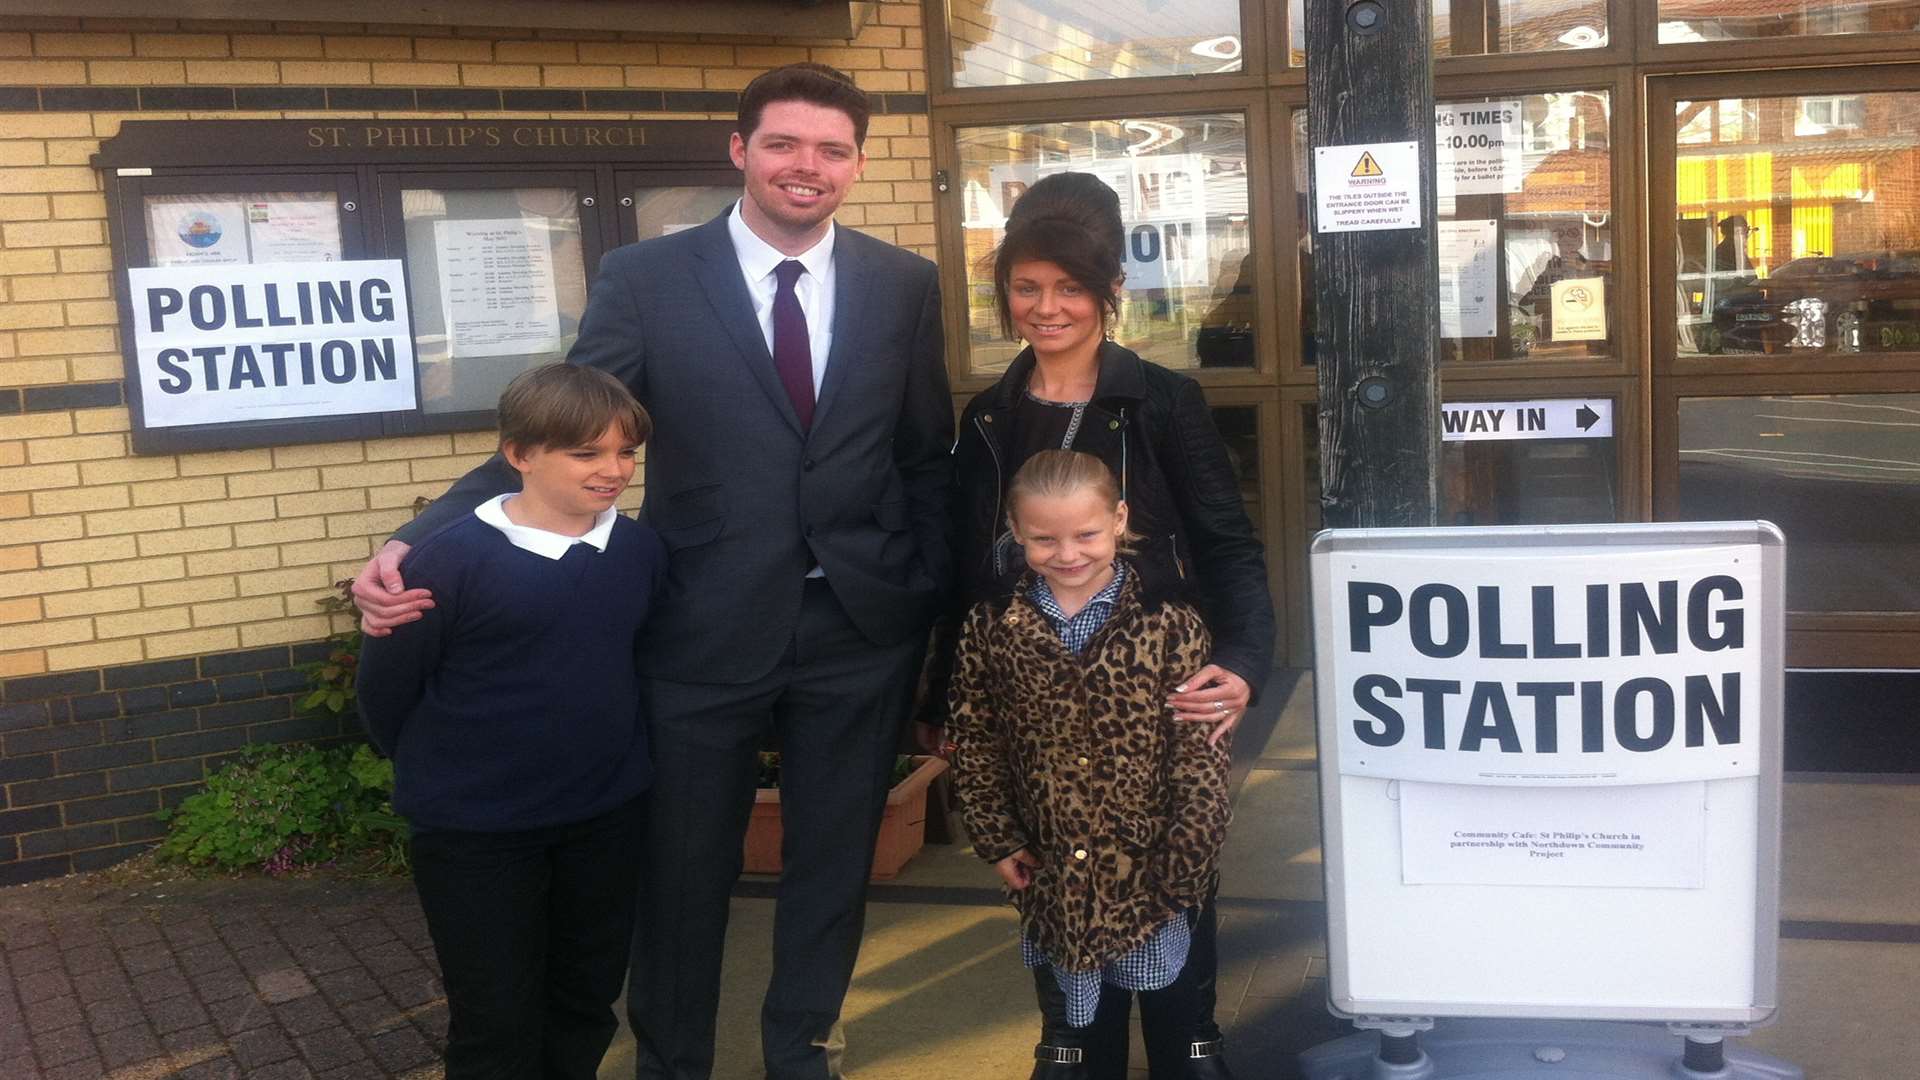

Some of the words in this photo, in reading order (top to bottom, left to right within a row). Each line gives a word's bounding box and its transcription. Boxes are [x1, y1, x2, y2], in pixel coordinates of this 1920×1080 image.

[1460, 110, 1513, 125] TIMES
[308, 127, 352, 147] ST.
[366, 127, 501, 147] PHILIP'S
[513, 126, 647, 146] CHURCH
[1446, 134, 1505, 150] 10.00pm
[1348, 178, 1387, 186] WARNING
[1361, 217, 1402, 225] CAREFULLY
[147, 278, 395, 332] POLLING
[157, 338, 397, 395] STATION
[1442, 409, 1505, 433] WAY
[1517, 408, 1546, 431] IN
[1347, 574, 1745, 659] POLLING
[1353, 672, 1742, 753] STATION
[1454, 830, 1509, 841] Community
[1540, 831, 1550, 840] St
[1553, 831, 1589, 841] Philip's
[1592, 831, 1629, 841] Church
[1631, 832, 1641, 841] in
[1450, 840, 1505, 849] partnership
[1508, 840, 1529, 848] with
[1531, 840, 1585, 849] Northdown
[1587, 841, 1645, 850] Community
[1529, 849, 1564, 859] Project
